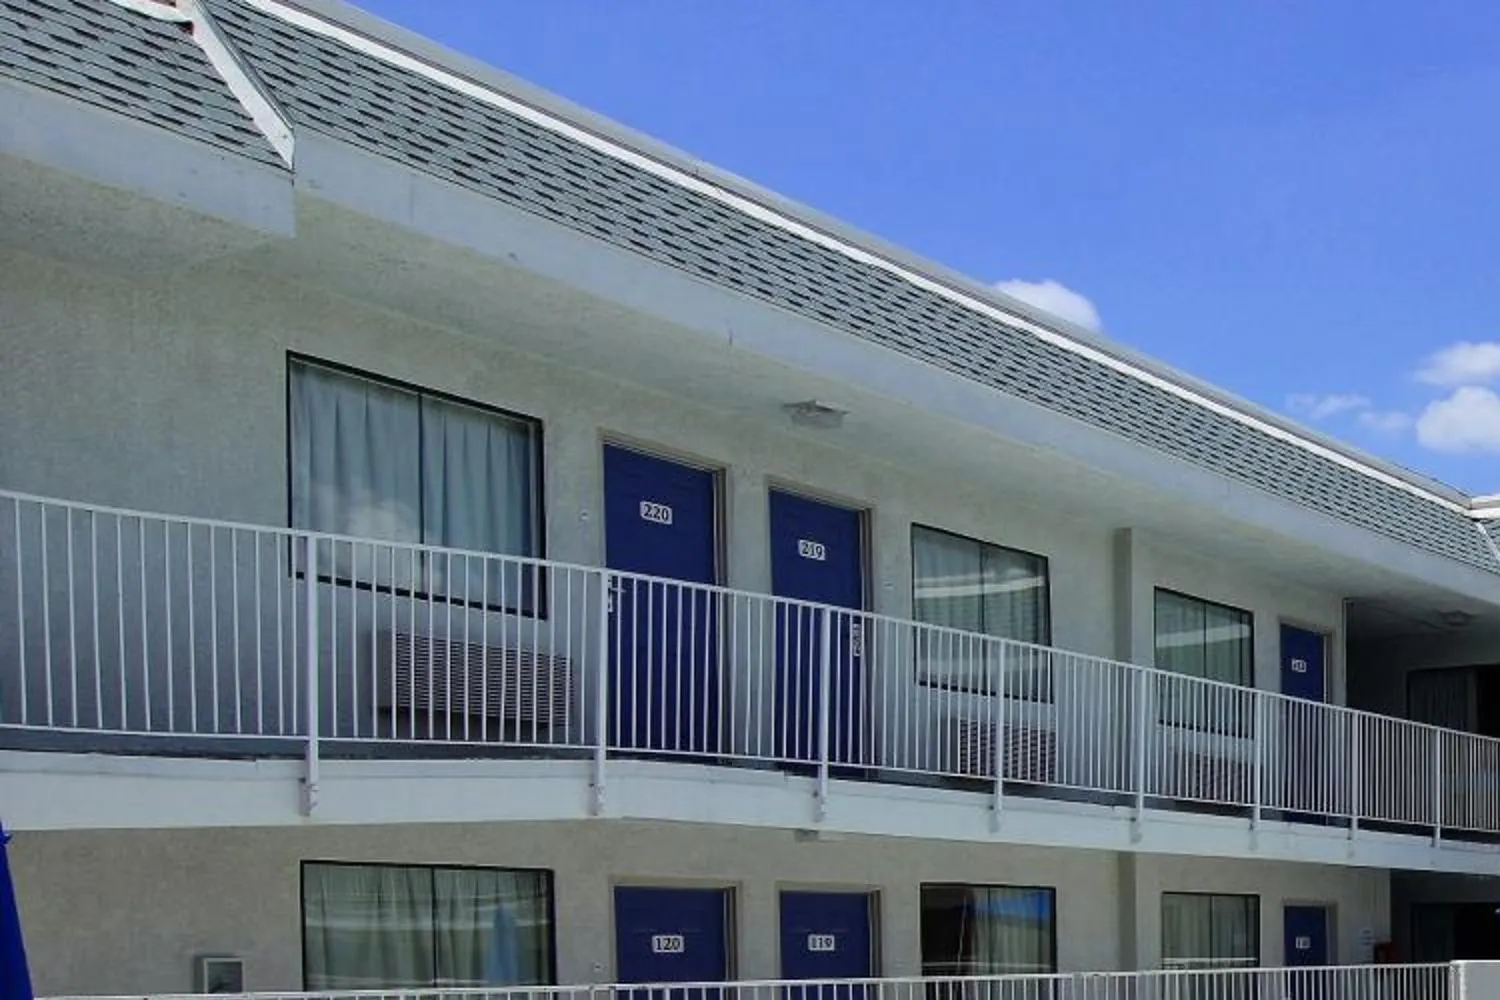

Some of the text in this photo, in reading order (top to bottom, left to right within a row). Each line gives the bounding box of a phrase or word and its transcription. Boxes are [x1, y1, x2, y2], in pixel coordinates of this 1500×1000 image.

[643, 503, 669, 522] 220
[801, 542, 823, 559] 219
[655, 937, 682, 951] 120
